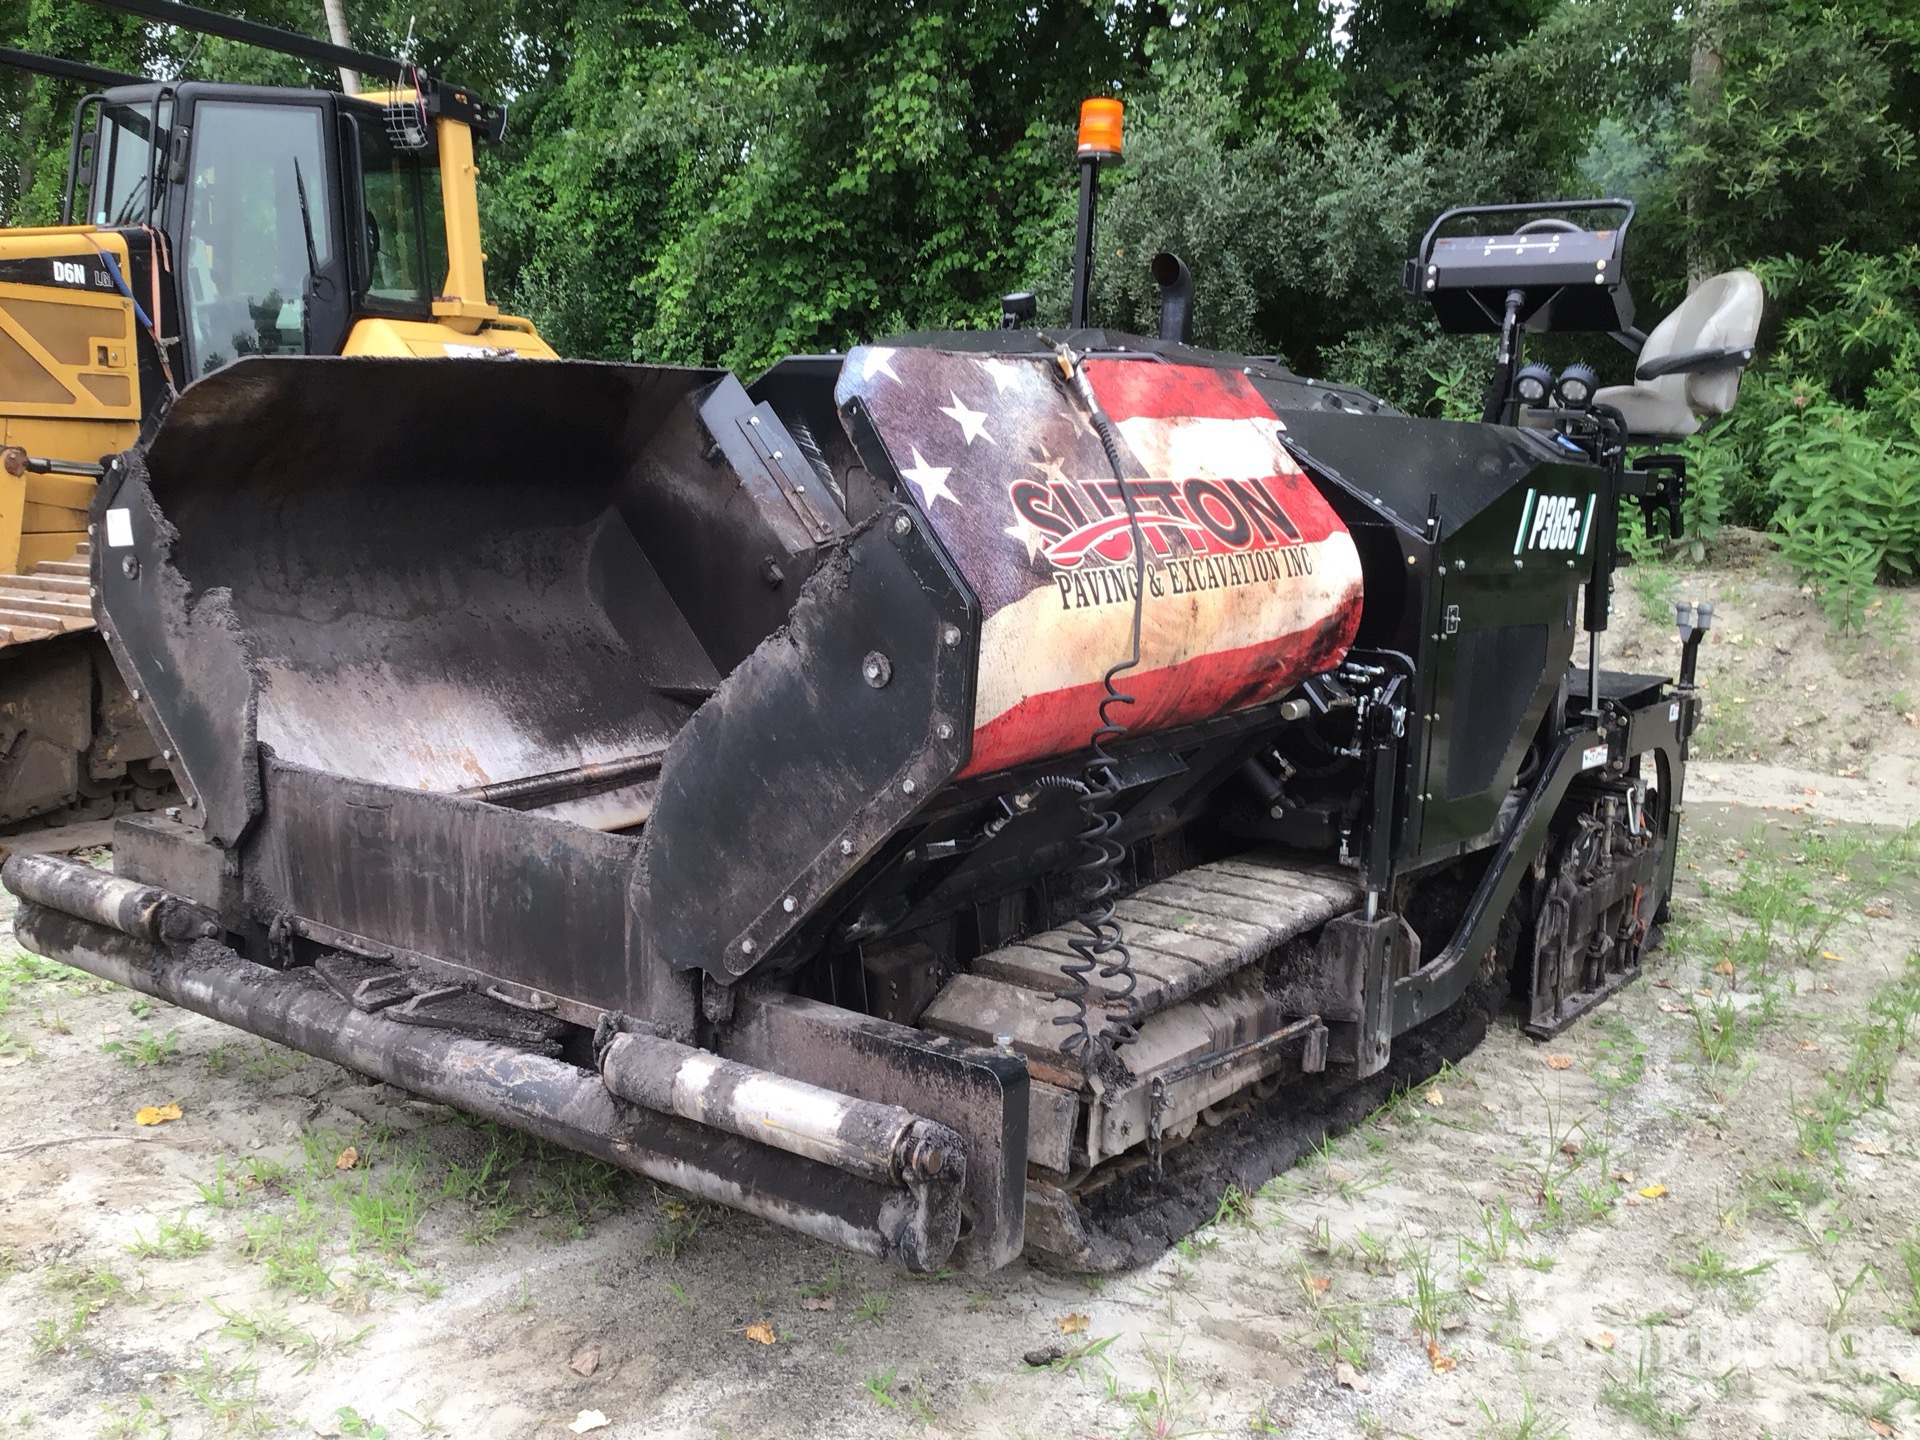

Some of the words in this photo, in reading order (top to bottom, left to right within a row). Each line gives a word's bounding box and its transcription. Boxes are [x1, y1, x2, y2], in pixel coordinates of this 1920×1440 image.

[53, 261, 86, 284] D6N
[94, 270, 114, 287] LG
[1009, 477, 1303, 568] SUTTON
[1055, 565, 1139, 610] PAVING
[1146, 563, 1164, 598] &
[1166, 550, 1281, 594] EXCAVATION
[1281, 546, 1312, 577] INC
